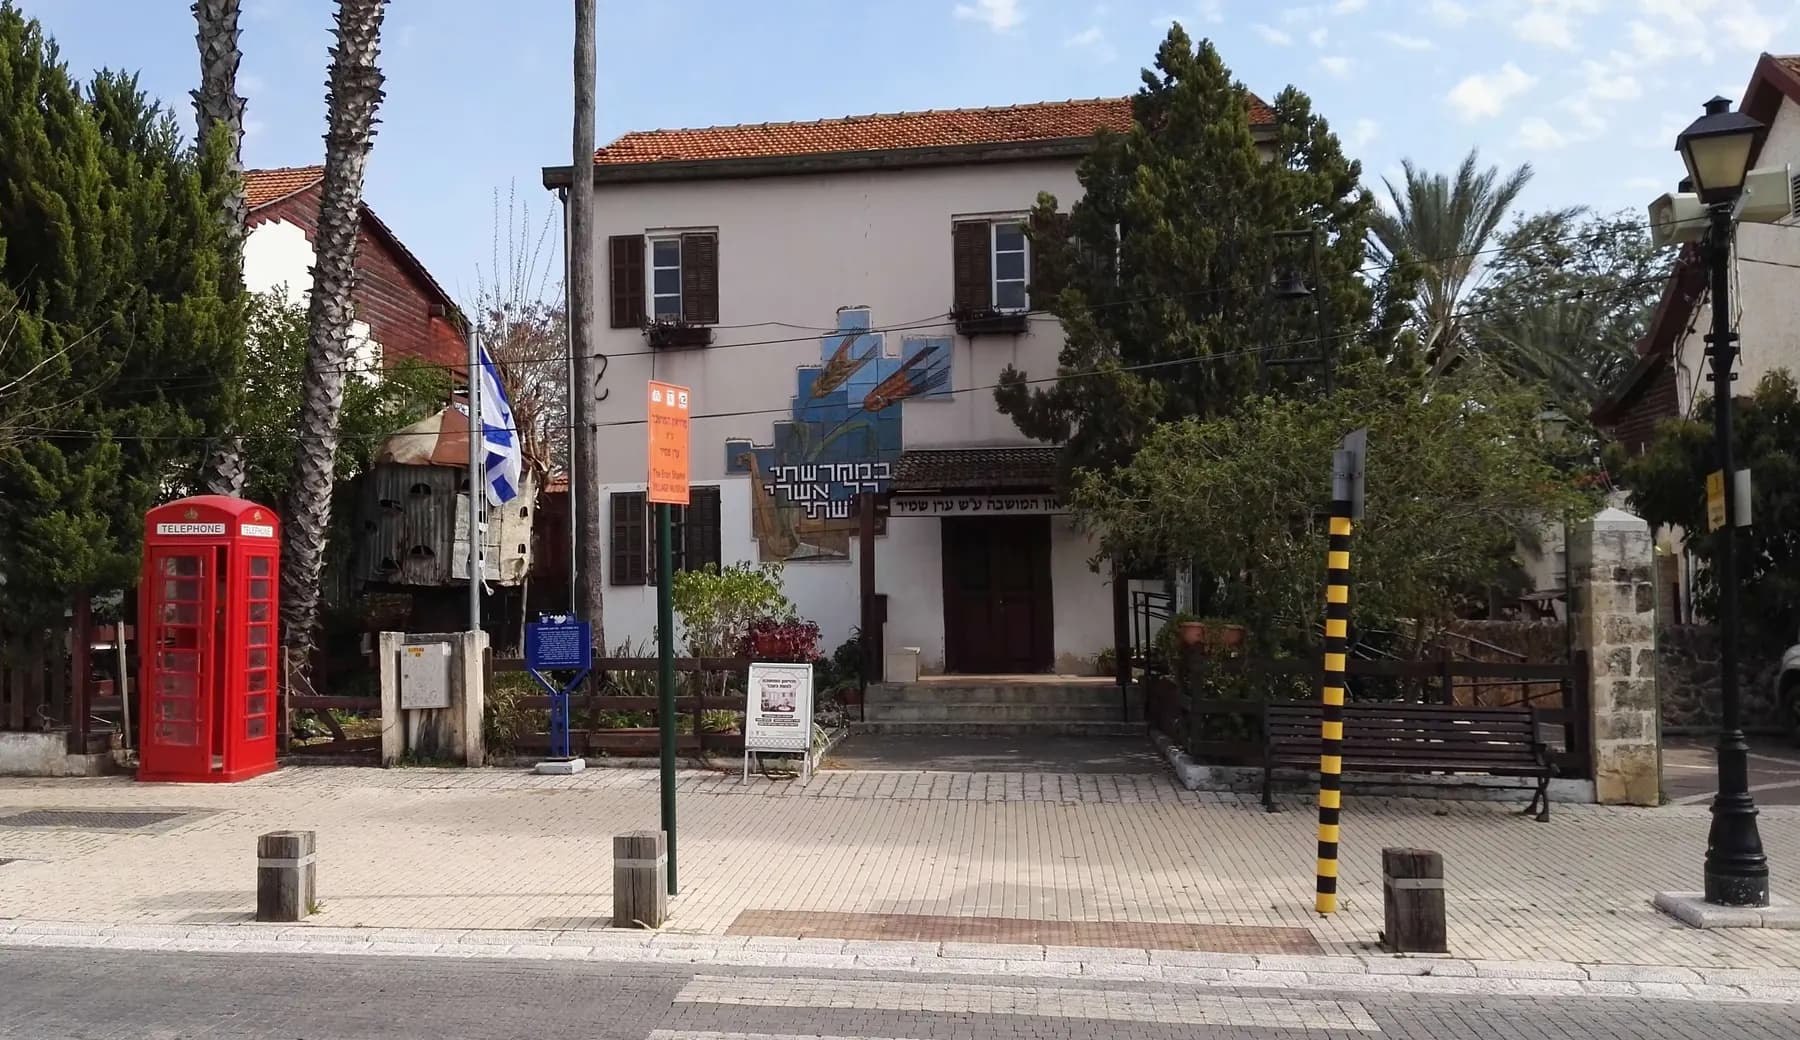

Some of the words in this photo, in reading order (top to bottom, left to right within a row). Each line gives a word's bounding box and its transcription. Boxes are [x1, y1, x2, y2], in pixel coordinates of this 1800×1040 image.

[896, 501, 929, 513] שמיר
[933, 500, 953, 513] ערן
[986, 499, 1039, 512] המושבה
[162, 525, 221, 533] TELEPHONE
[243, 525, 271, 536] TELEPHONE
